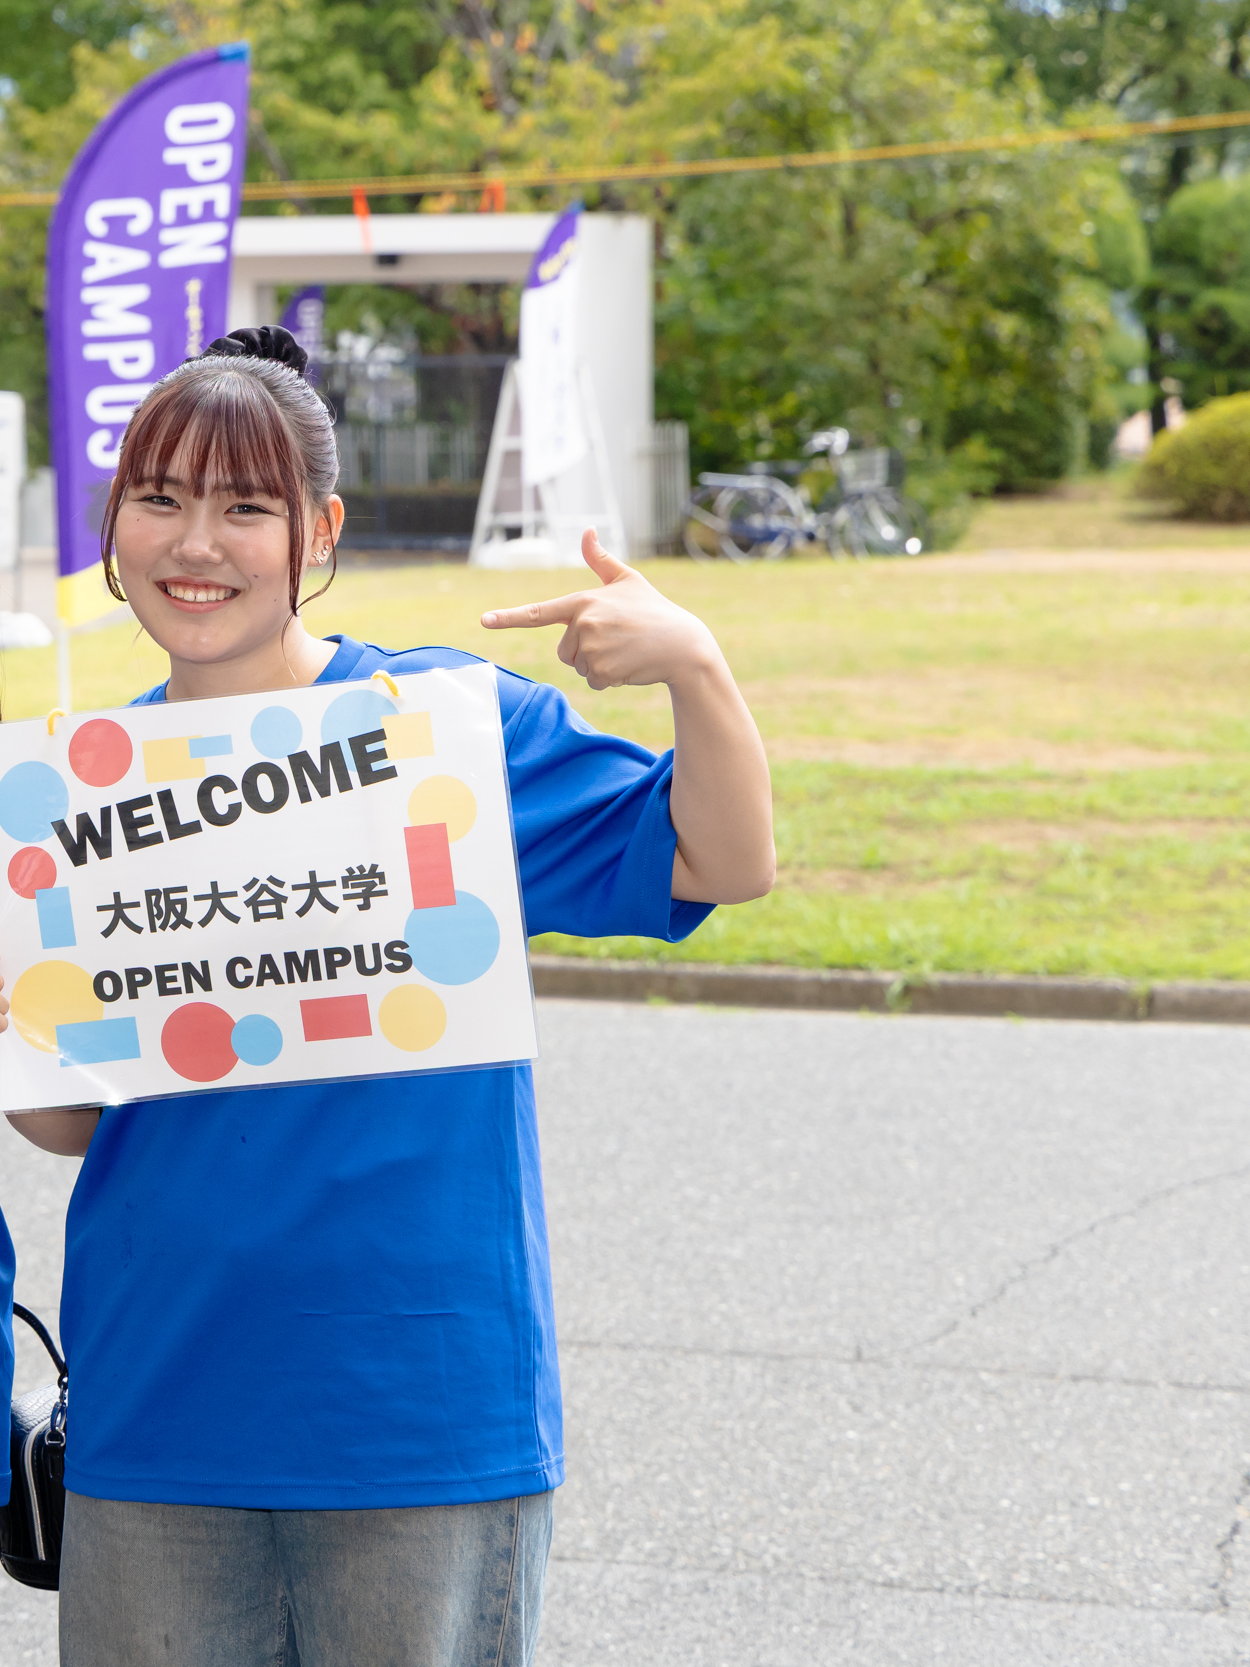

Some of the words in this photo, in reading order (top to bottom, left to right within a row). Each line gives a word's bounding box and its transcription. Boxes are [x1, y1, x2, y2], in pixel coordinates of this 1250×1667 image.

[158, 101, 235, 269] OPEN
[51, 728, 398, 868] WELCOME
[96, 863, 389, 939] 大阪大谷大学
[92, 960, 213, 1003] OPEN
[225, 939, 413, 989] CAMPUS
